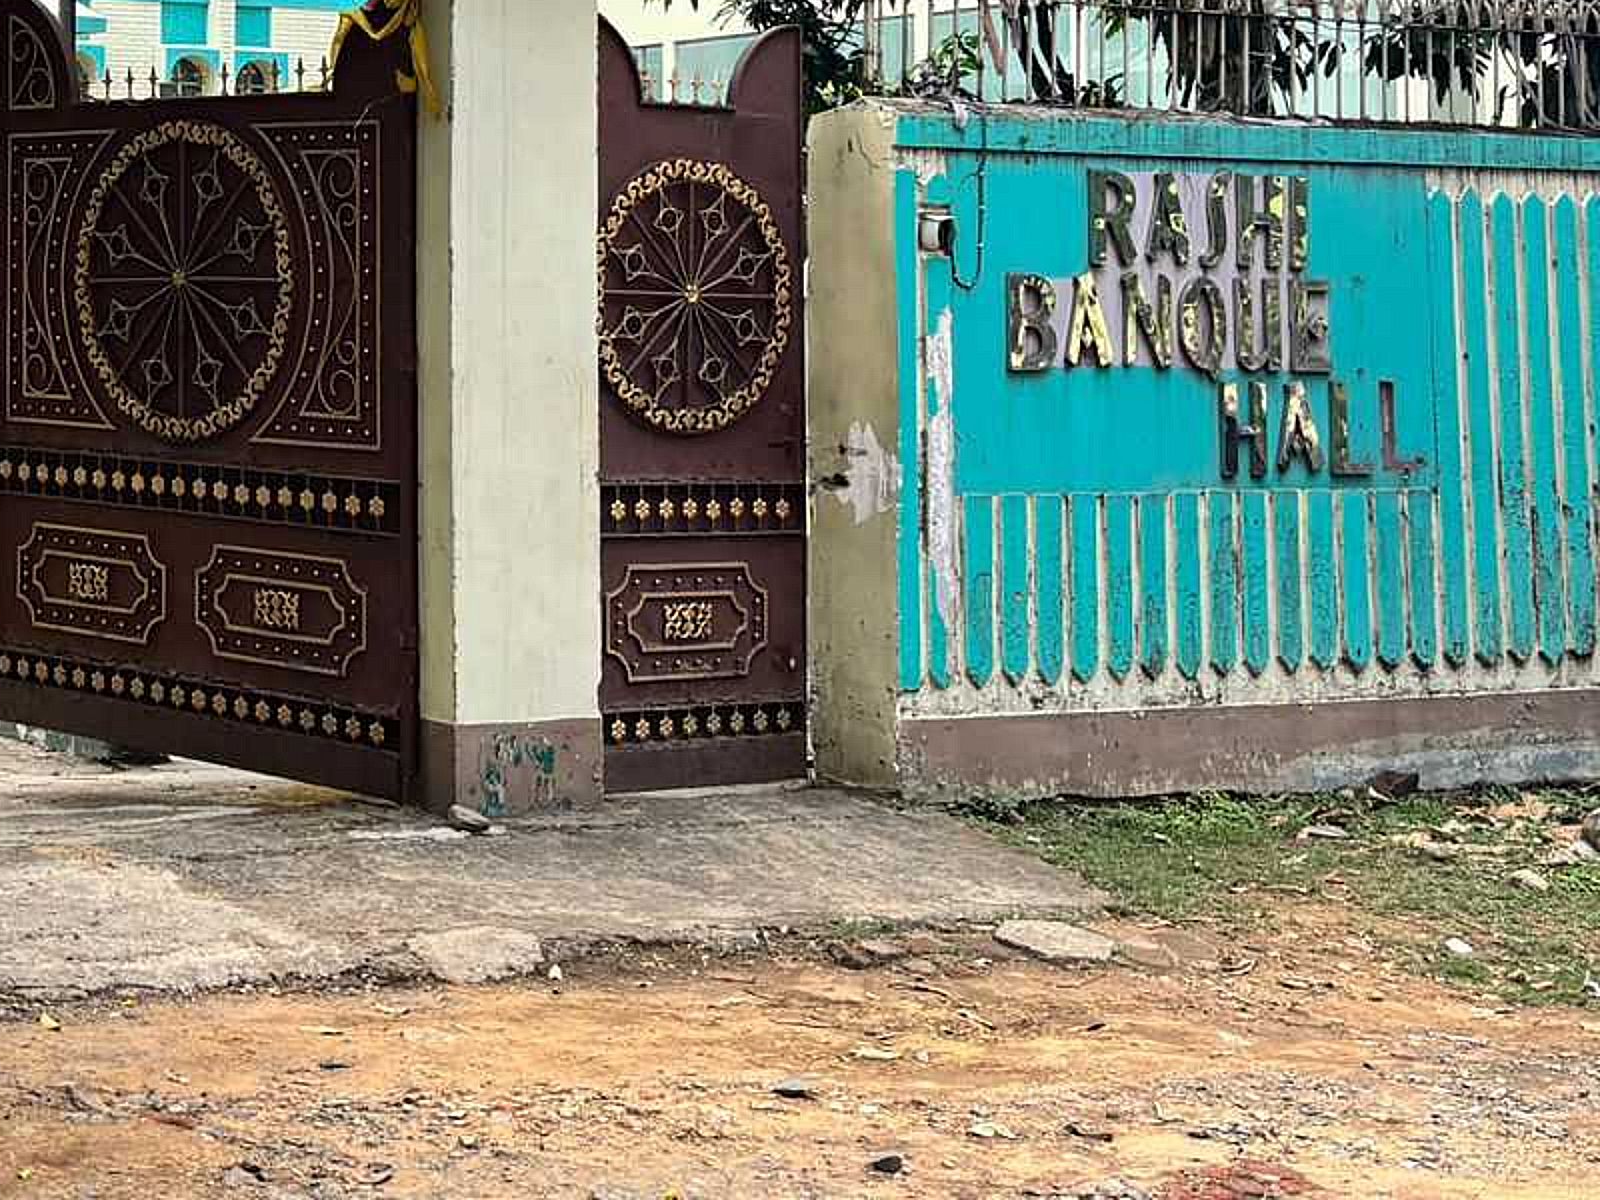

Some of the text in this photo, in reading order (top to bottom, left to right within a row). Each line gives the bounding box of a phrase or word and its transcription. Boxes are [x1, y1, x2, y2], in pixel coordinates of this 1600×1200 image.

[1087, 167, 1310, 272] RASHI
[1006, 271, 1331, 382] BANQUE
[1219, 379, 1425, 480] HALL
